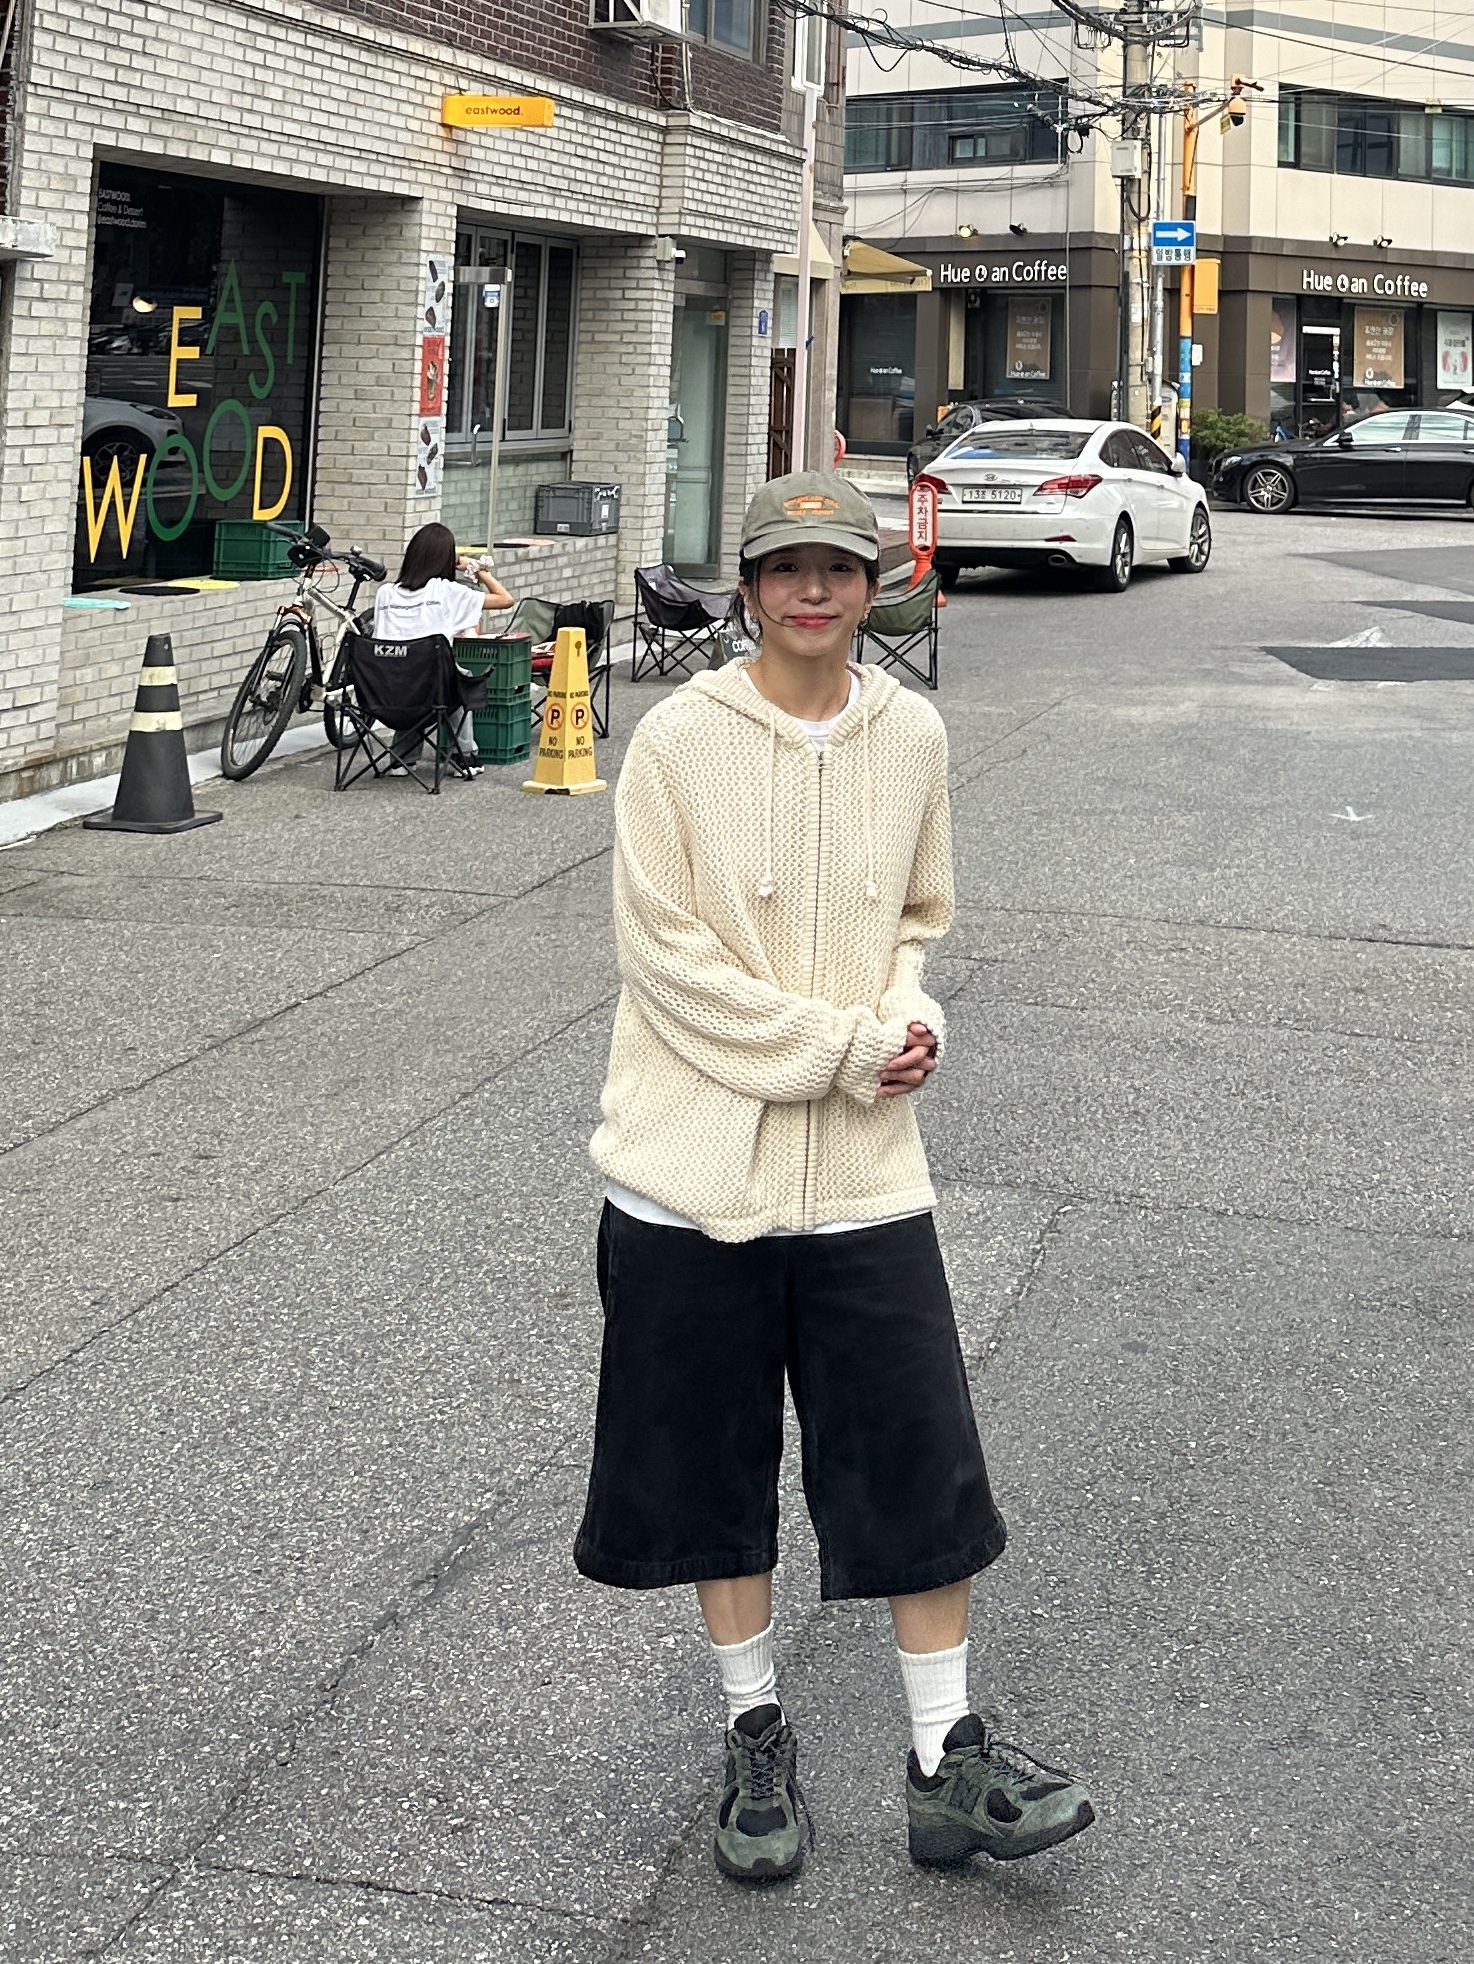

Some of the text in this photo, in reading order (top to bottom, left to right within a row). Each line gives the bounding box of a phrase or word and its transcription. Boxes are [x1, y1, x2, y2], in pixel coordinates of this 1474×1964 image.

[940, 263, 971, 283] Hue
[1012, 260, 1067, 282] Coffee
[1302, 269, 1333, 291] Hue
[1373, 273, 1428, 298] Coffee
[990, 489, 1017, 501] 5120
[916, 494, 928, 542] 주차금지
[374, 644, 408, 656] KZM
[548, 736, 557, 746] NO
[576, 736, 585, 746] NO
[539, 747, 563, 759] PARKING
[568, 746, 592, 759] PARKING
